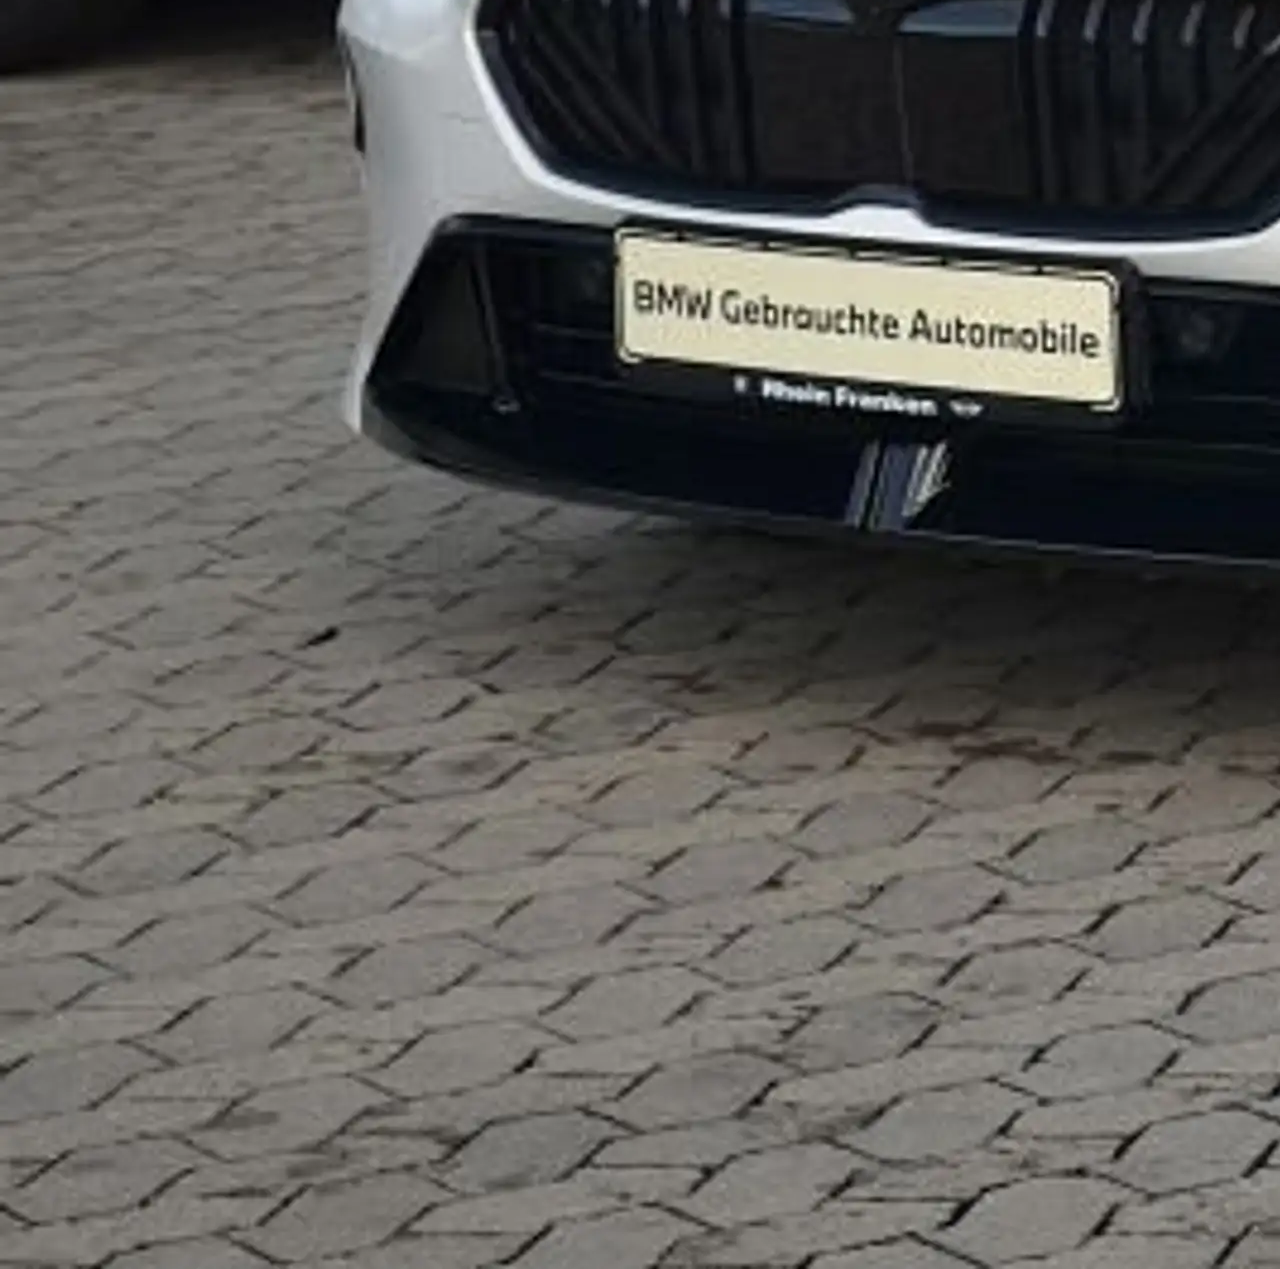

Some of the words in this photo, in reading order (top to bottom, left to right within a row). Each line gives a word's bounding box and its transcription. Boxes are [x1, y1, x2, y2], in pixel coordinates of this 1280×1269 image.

[633, 280, 712, 320] BMW
[720, 289, 900, 340] Gebrauchte
[908, 308, 1101, 358] Automobile
[762, 378, 831, 406] Rhein
[834, 385, 938, 416] Franken
